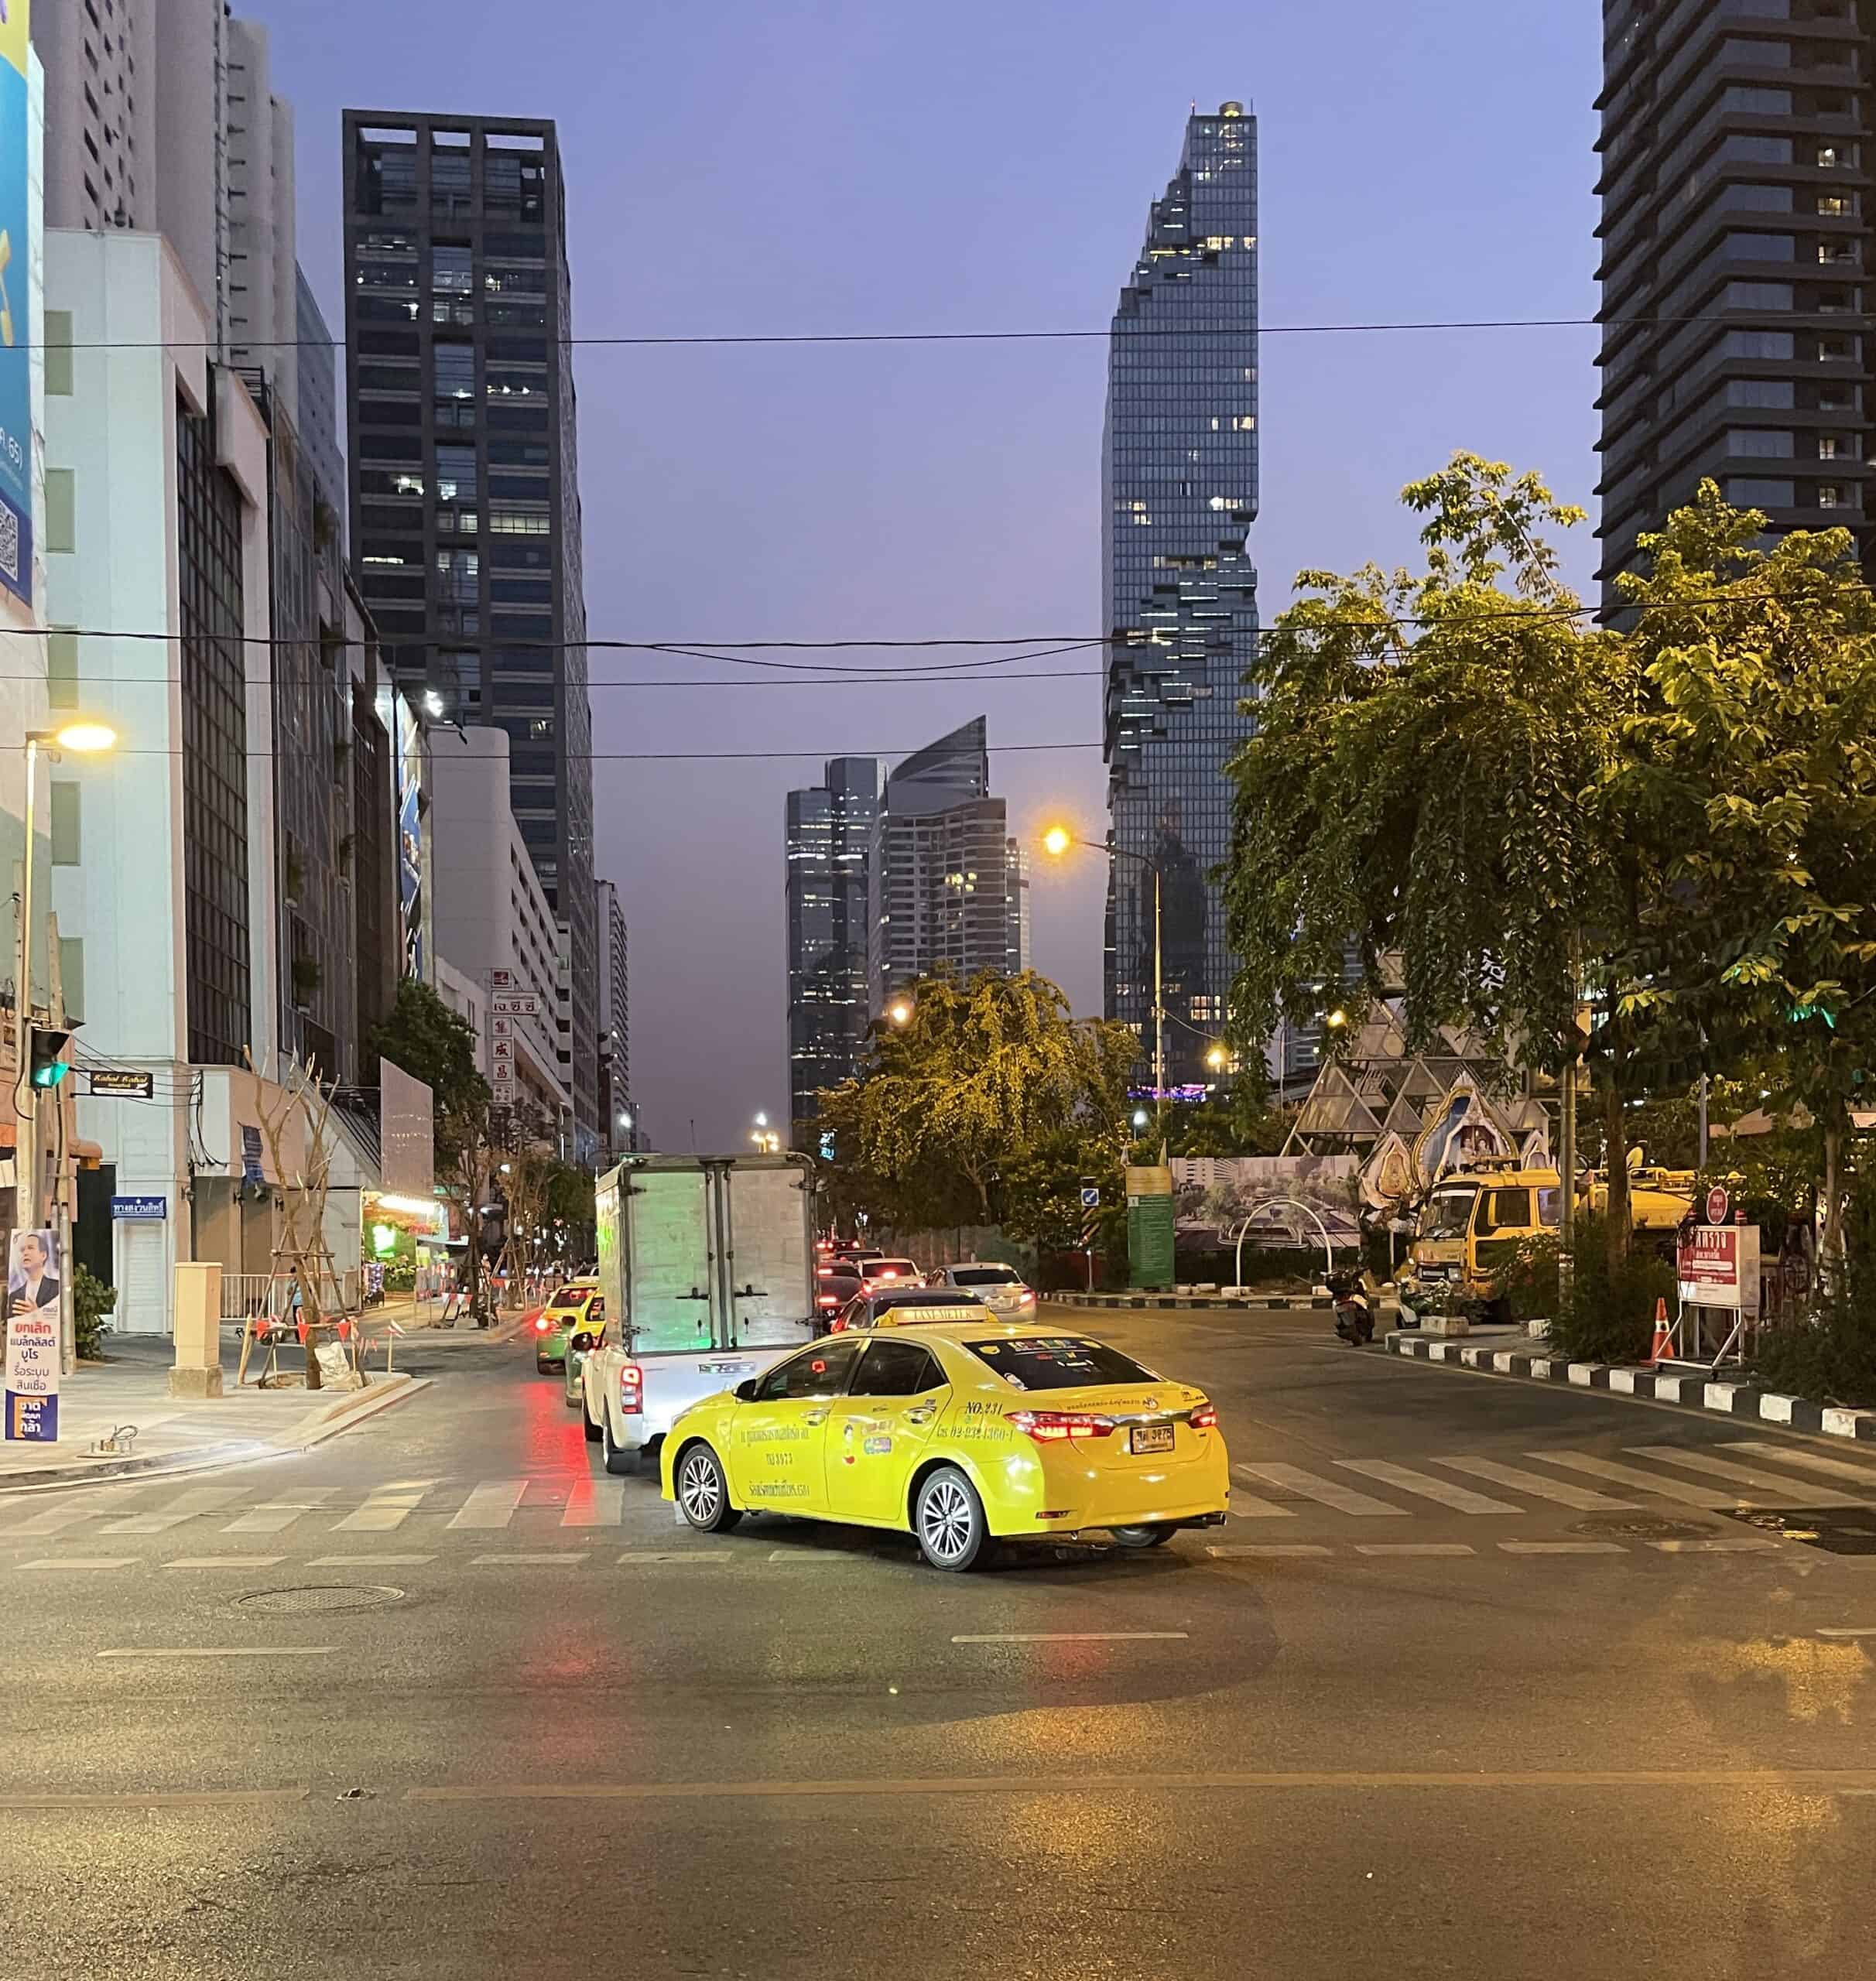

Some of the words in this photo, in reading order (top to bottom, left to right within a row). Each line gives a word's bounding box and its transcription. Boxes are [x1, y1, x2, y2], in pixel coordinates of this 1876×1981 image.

[15, 1322, 52, 1334] ยกเลิก
[21, 1348, 39, 1363] บูโร
[16, 1378, 46, 1391] สินเชื่อ
